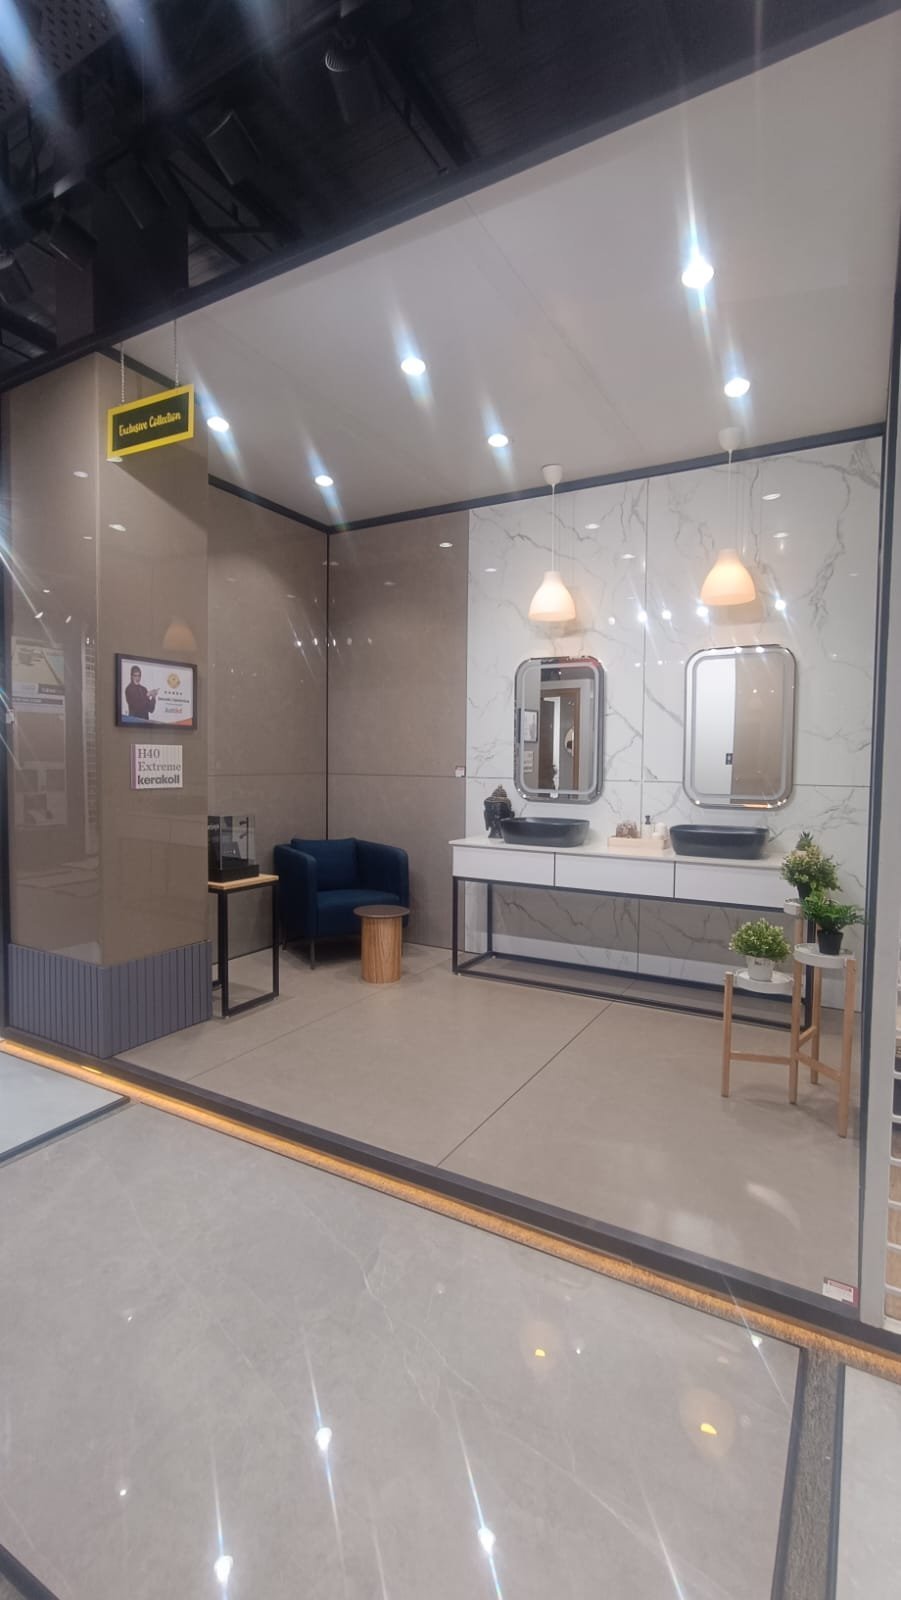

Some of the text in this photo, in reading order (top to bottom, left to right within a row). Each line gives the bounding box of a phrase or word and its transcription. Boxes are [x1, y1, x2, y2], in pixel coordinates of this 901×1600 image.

[118, 411, 182, 437] Exclusive Collection
[138, 748, 160, 759] H40
[138, 761, 181, 772] Extreme
[137, 774, 180, 785] kerakoll
